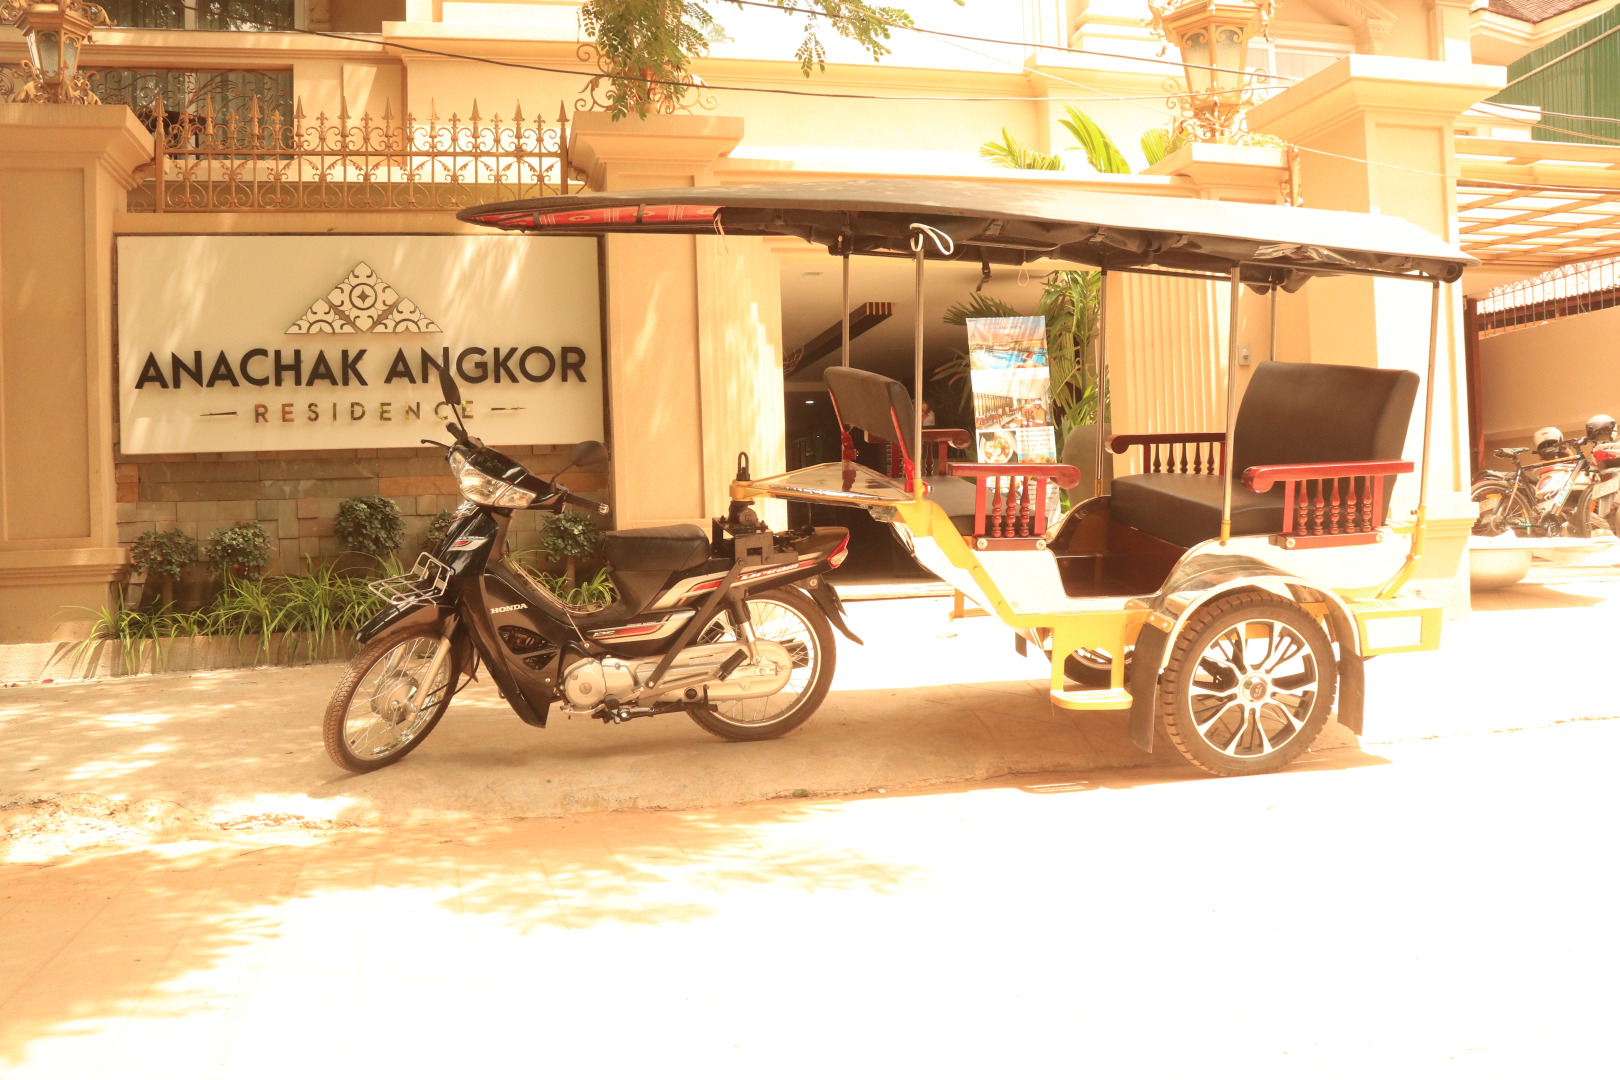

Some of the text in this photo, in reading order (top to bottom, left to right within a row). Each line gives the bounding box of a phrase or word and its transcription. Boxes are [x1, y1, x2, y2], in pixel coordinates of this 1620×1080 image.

[135, 346, 588, 389] ANACHAK ANGKOR
[254, 400, 474, 424] RESIDENCE
[740, 563, 800, 581] Dream
[490, 603, 529, 614] HONDA
